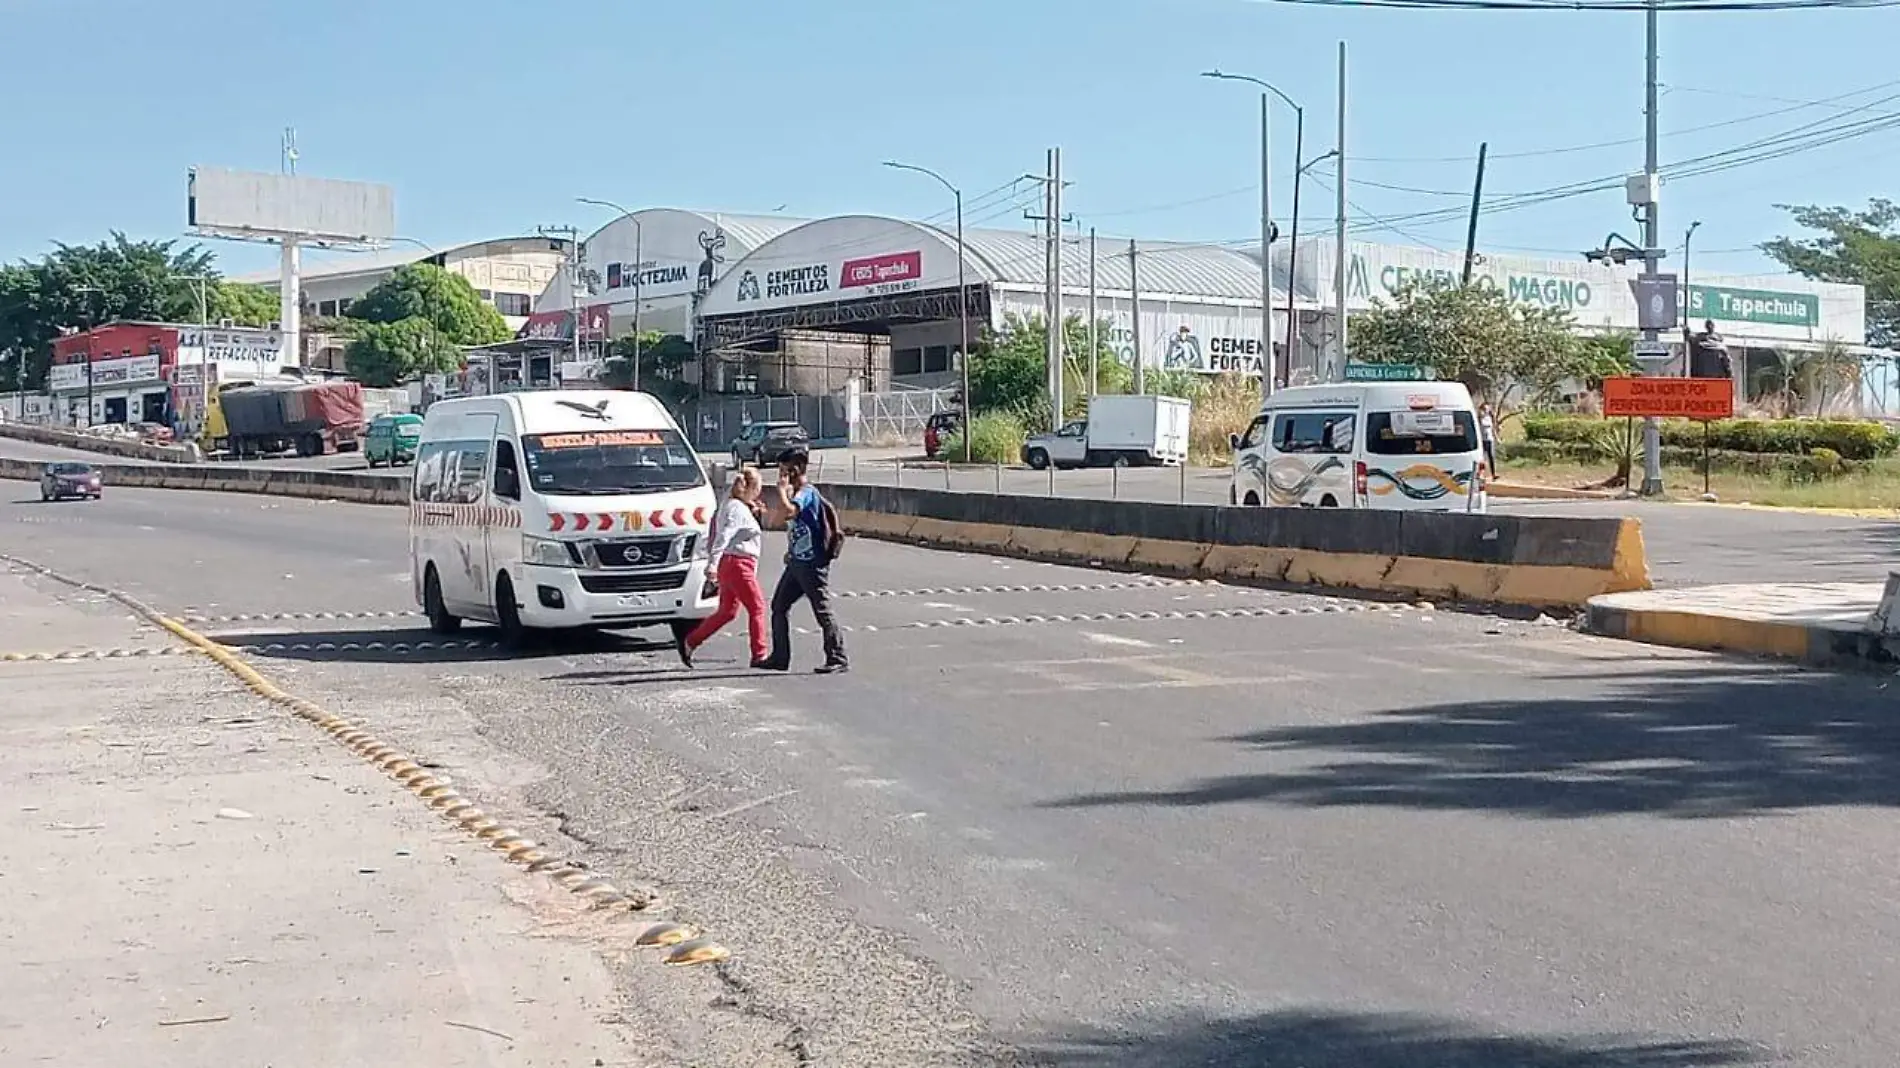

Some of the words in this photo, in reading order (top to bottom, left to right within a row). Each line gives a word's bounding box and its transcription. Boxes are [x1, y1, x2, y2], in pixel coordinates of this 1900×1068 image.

[622, 265, 688, 288] MOCTEZUMA
[767, 264, 828, 284] CEMENTOS
[767, 279, 830, 298] FORTALEZA
[1380, 264, 1495, 297] CEMENO
[1508, 275, 1591, 308] MAGNO
[1676, 288, 1704, 309] DIS
[1719, 293, 1807, 317] Tapachula
[207, 346, 279, 361] REFACCIONES
[1630, 382, 1654, 395] ZONA
[1657, 382, 1685, 396] NORTE
[1687, 382, 1709, 396] POR
[1685, 399, 1729, 413] PONIENTE
[619, 510, 642, 531] 70
